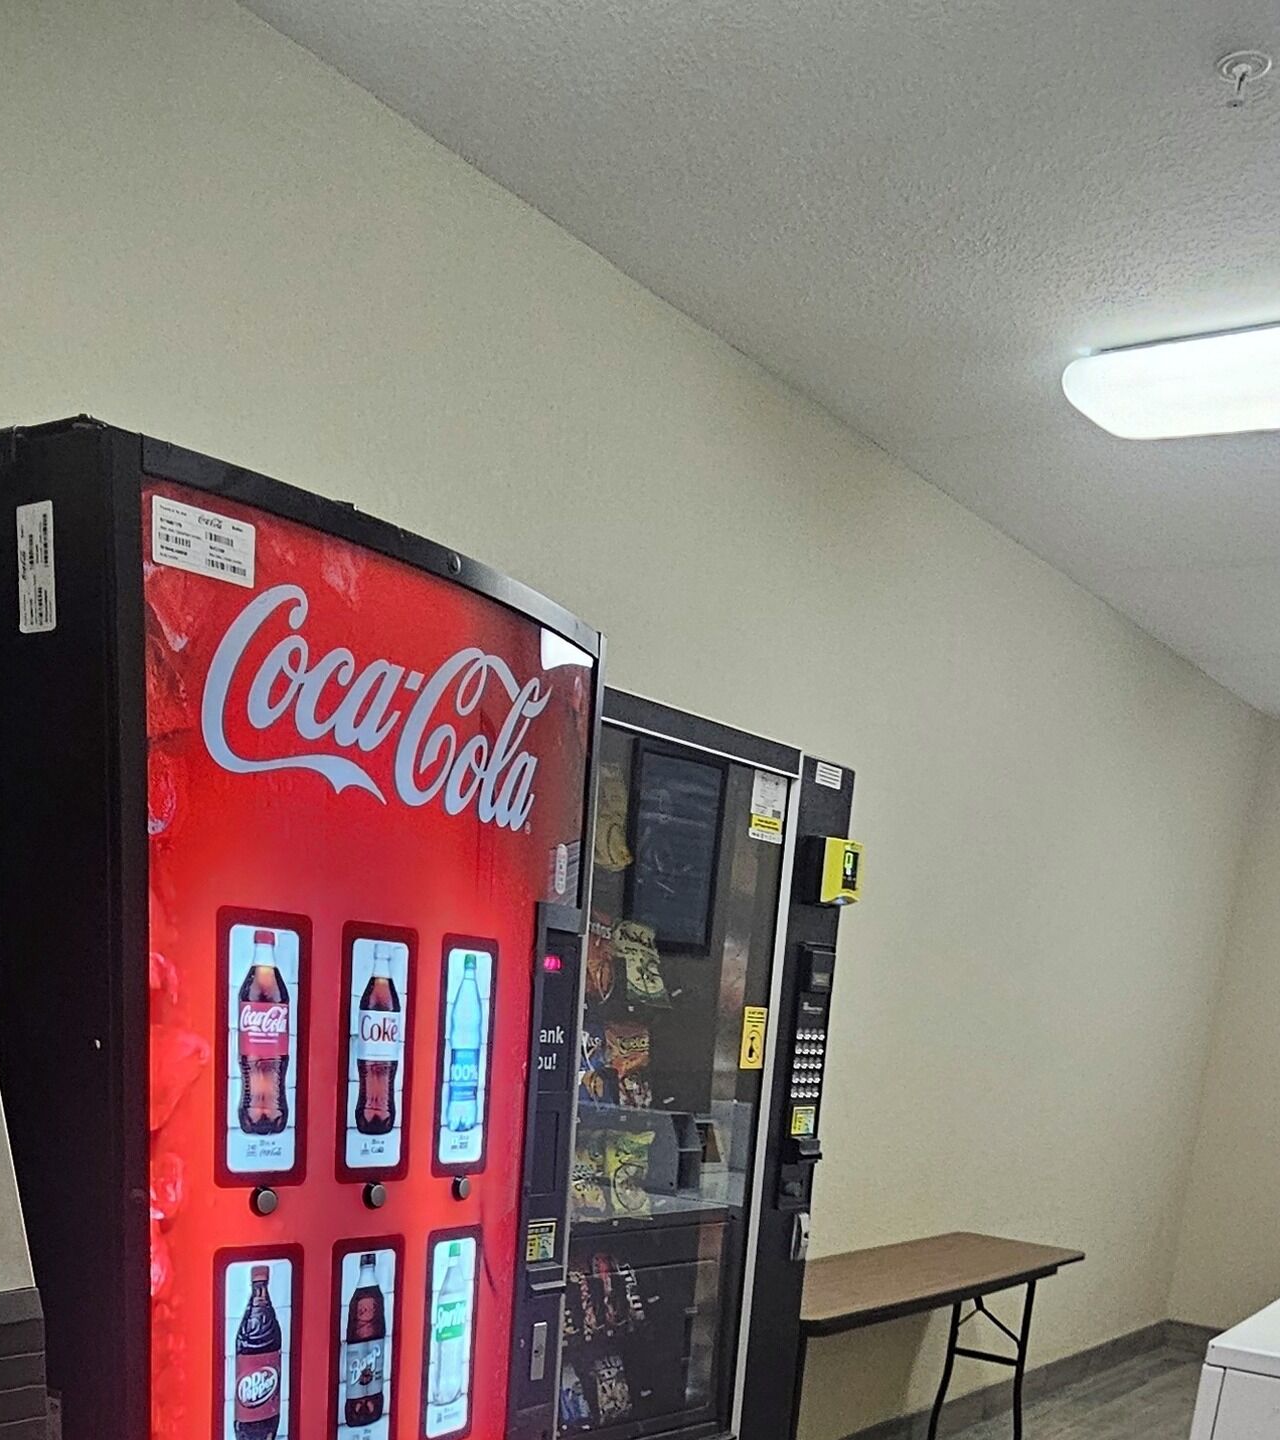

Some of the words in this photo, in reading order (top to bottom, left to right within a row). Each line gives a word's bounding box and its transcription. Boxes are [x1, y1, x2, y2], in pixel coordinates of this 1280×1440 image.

[201, 584, 552, 832] Coca-Cola
[240, 1004, 288, 1032] Coca-Cola
[361, 1014, 398, 1042] Coke
[539, 1025, 565, 1044] ank
[537, 1053, 557, 1070] ou!
